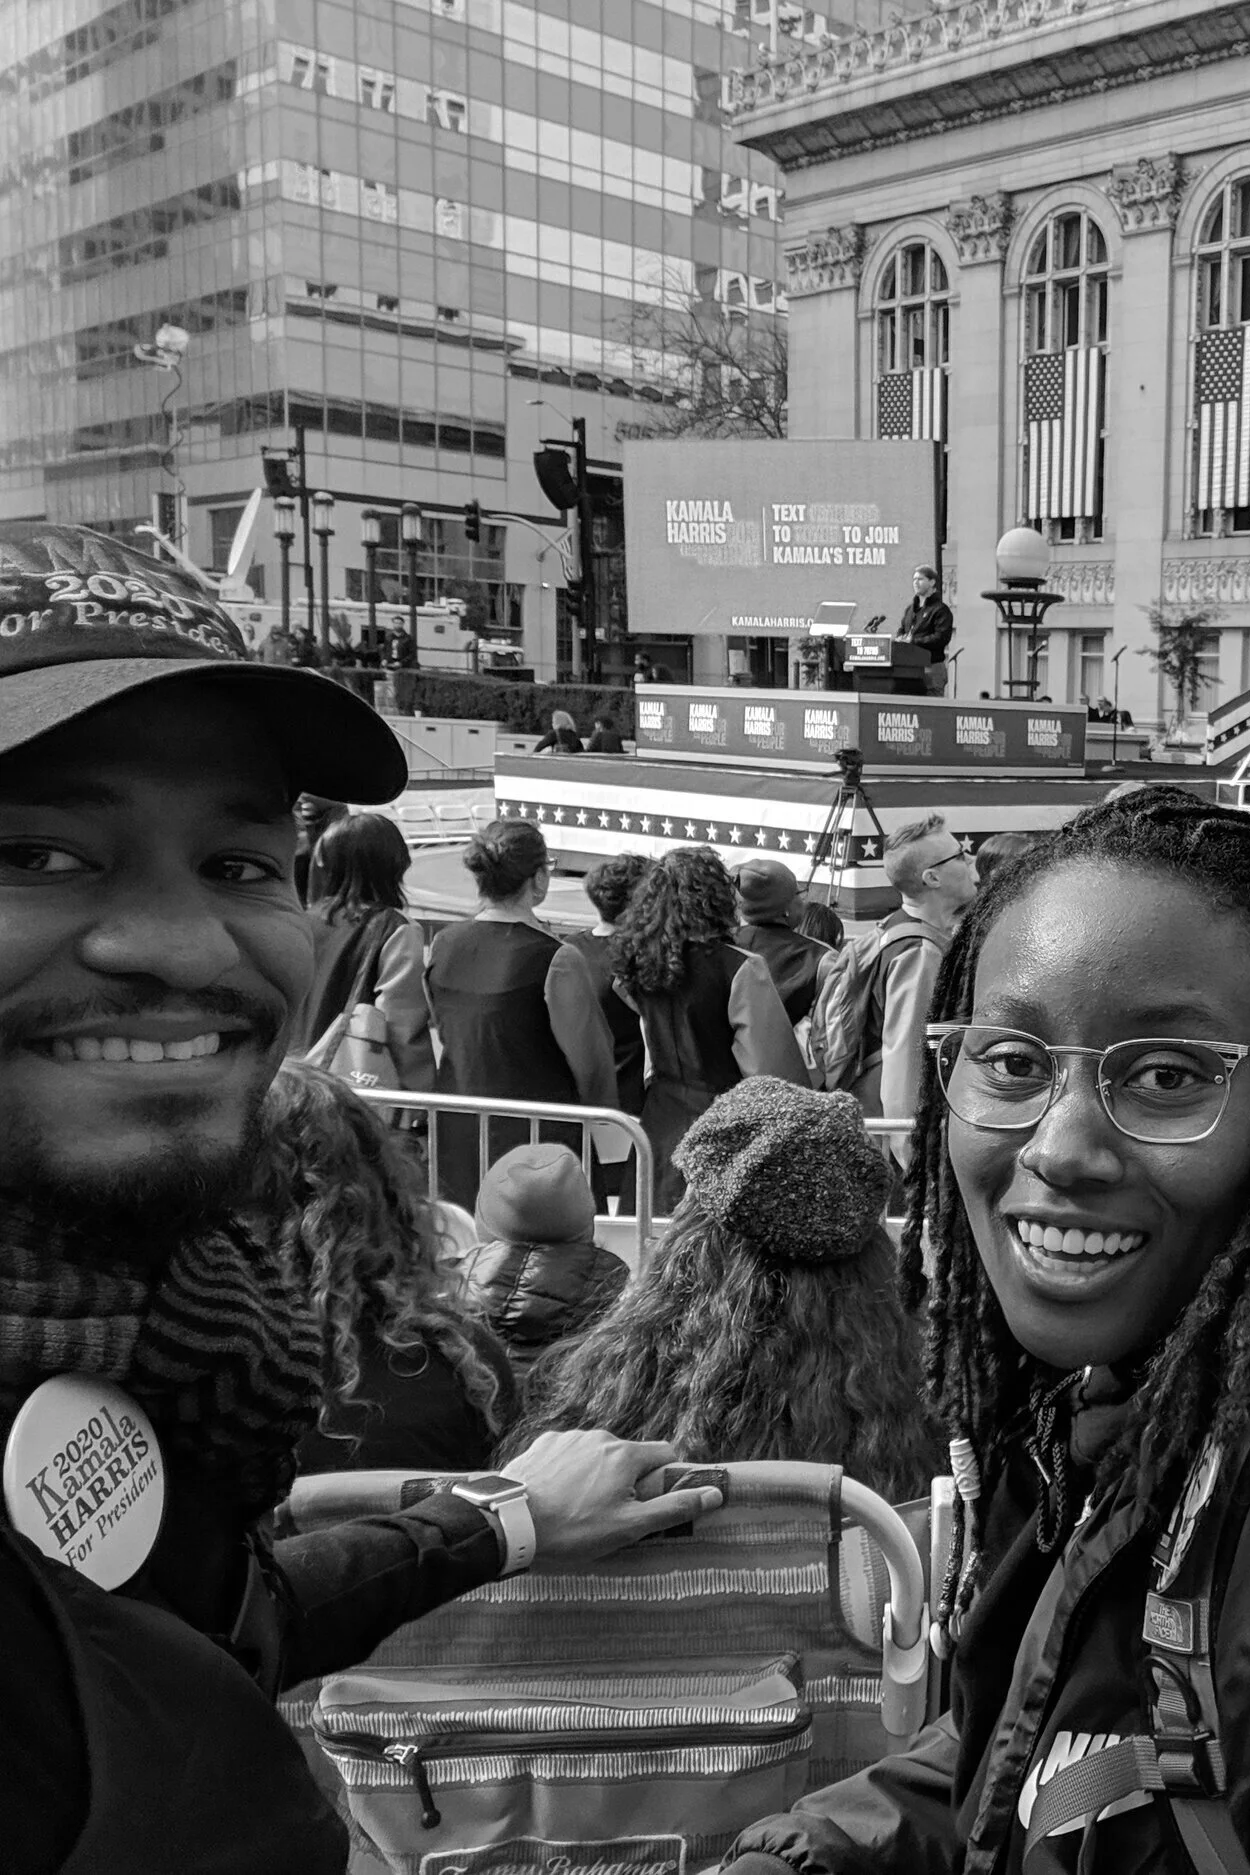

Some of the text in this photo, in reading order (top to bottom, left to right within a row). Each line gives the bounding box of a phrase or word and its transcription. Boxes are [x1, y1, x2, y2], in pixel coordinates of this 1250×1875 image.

[666, 500, 734, 522] KAMALA
[772, 504, 806, 522] TEXT
[667, 522, 727, 543] HARRIS
[773, 525, 791, 543] TO
[843, 526, 862, 544] TO
[864, 526, 900, 544] JOIN
[773, 546, 843, 565] KAMALA'S
[847, 548, 886, 565] TEAM
[45, 574, 194, 619] 2020
[732, 616, 814, 628] KAMALAHARRIS.O
[0, 601, 245, 660] or Presiden
[640, 701, 664, 716] KAMALA
[689, 703, 717, 719] KAMALA
[744, 706, 775, 722] KAMALA
[640, 715, 662, 729] HARRIS
[689, 717, 714, 732] HARRIS
[804, 709, 838, 726] KAMALA
[878, 712, 919, 728] KAMALA
[956, 716, 994, 731] KAMALA
[1027, 718, 1062, 733] KAMALA
[744, 720, 771, 735] HARRIS
[804, 723, 834, 739] HARRIS
[878, 727, 914, 742] HARRIS
[956, 730, 990, 744] HARRIS
[1027, 732, 1058, 746] HARRIS
[53, 1416, 104, 1479] 2020
[25, 1406, 136, 1524] Kamala
[50, 1429, 149, 1549] HARRIS
[65, 1458, 158, 1570] For President
